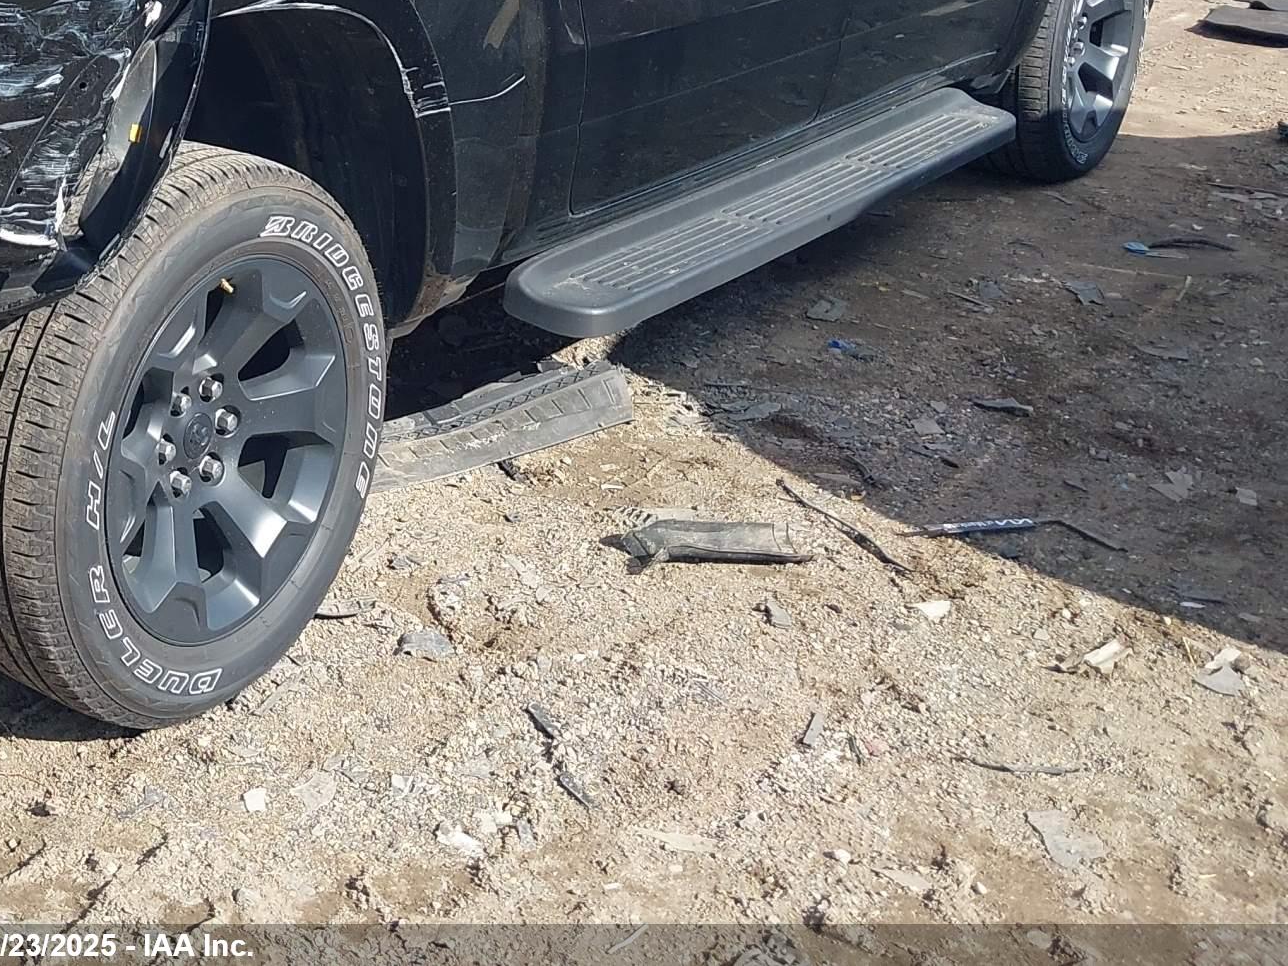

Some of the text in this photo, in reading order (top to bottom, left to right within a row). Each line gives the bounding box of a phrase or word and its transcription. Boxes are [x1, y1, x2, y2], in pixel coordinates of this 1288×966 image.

[260, 215, 384, 500] BRIDGESTONE
[86, 410, 223, 695] DUELER H/L
